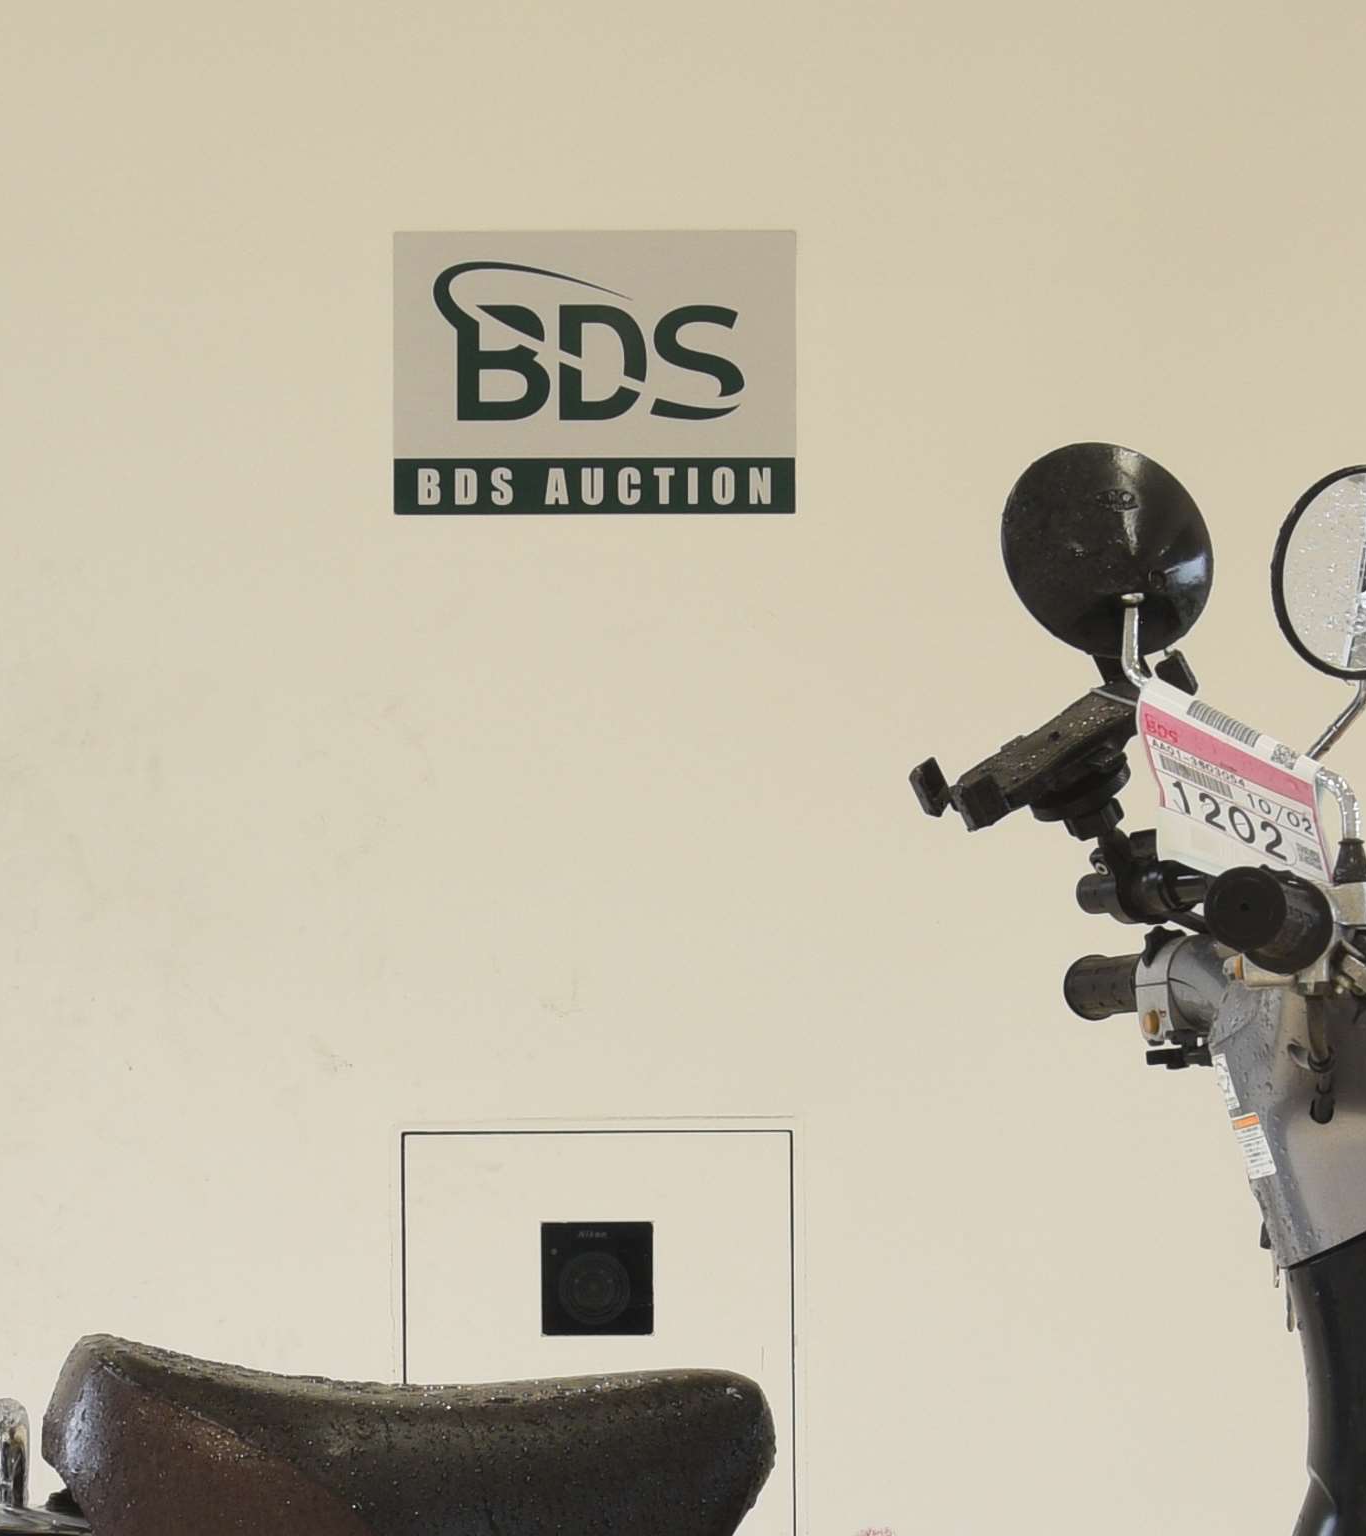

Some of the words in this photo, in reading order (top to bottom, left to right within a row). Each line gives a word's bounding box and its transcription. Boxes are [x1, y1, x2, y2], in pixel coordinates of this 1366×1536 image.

[433, 261, 745, 421] BDS
[417, 467, 514, 506] BDS
[544, 466, 772, 506] AUCTION
[1172, 781, 1287, 861] 1202
[1247, 793, 1315, 836] 10/02
